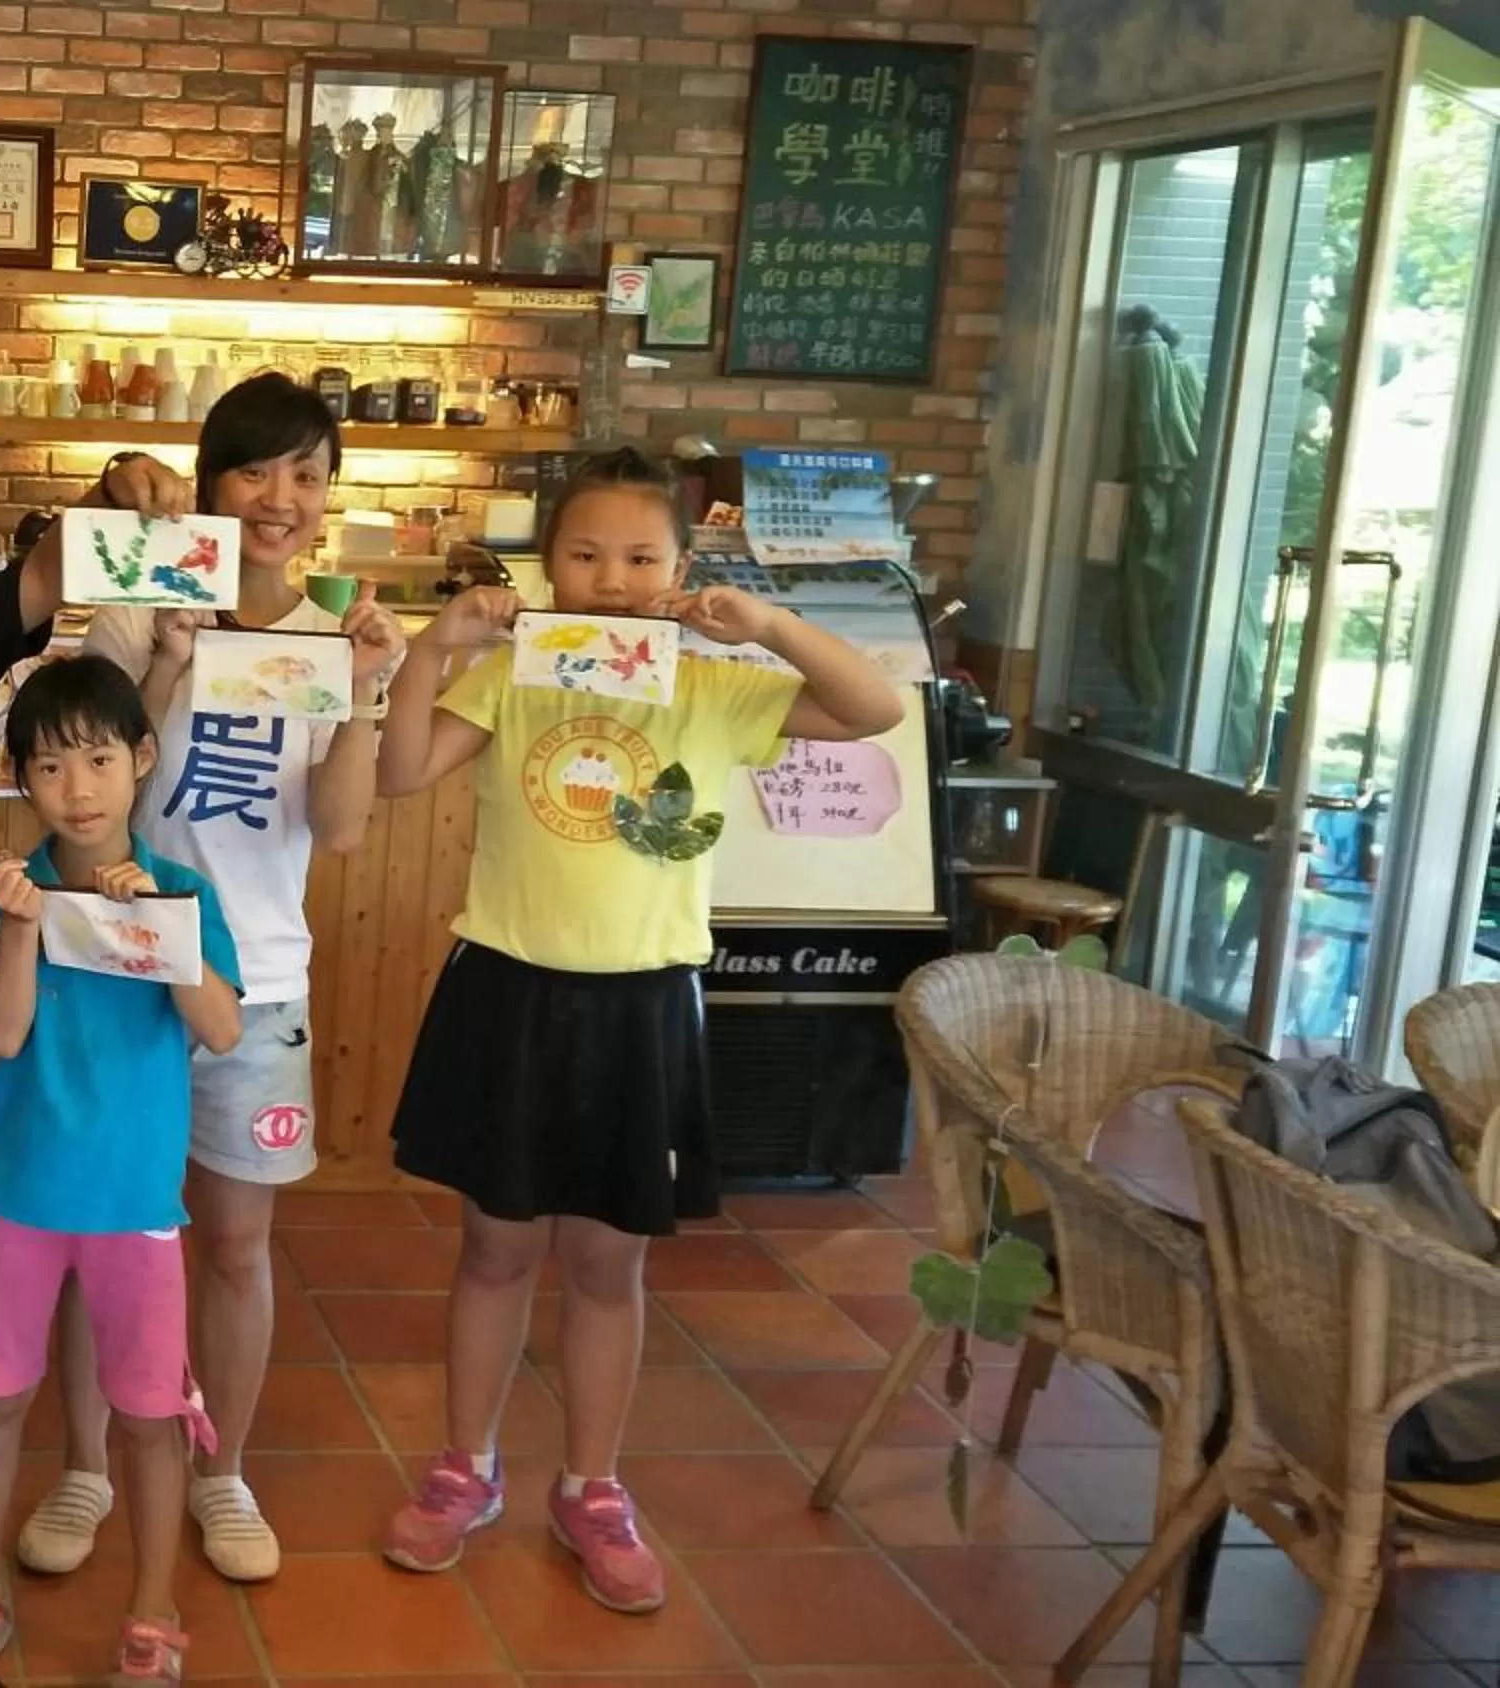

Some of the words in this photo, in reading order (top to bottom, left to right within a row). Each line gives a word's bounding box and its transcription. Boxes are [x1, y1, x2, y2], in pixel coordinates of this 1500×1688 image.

[784, 62, 897, 116] 咖啡
[774, 121, 891, 186] 學堂
[832, 203, 928, 230] KASA
[704, 947, 781, 974] lass
[791, 947, 878, 974] Cake
